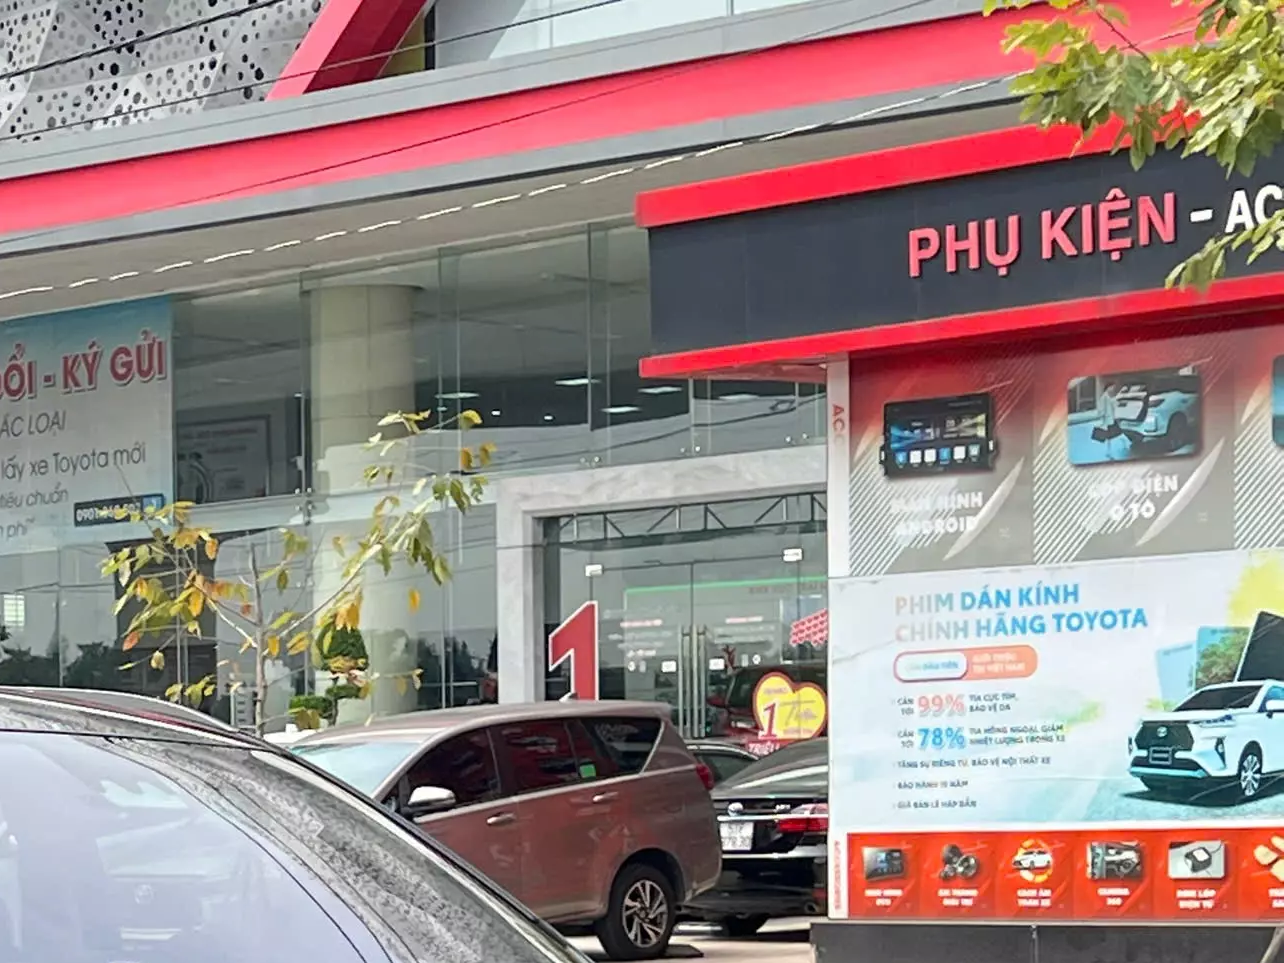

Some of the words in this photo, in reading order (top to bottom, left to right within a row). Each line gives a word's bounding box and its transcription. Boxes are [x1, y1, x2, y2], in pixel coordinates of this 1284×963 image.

[908, 215, 1020, 278] PHỤ
[1040, 188, 1176, 262] KIỆN
[62, 340, 103, 395] KÝ
[110, 329, 167, 386] GỬI
[28, 410, 66, 437] LOẠI
[1, 454, 24, 482] lấy
[30, 459, 48, 476] xe
[53, 449, 109, 476] Toyota
[113, 441, 146, 466] mới
[895, 592, 954, 616] PHIM
[960, 584, 1012, 611] DÁN
[1018, 580, 1079, 608] KÍNH
[895, 614, 970, 643] CHÍNH
[975, 610, 1046, 638] HÃNG
[1052, 607, 1148, 633] TOYOTA
[918, 694, 965, 716] 99%
[918, 727, 965, 750] 78%
